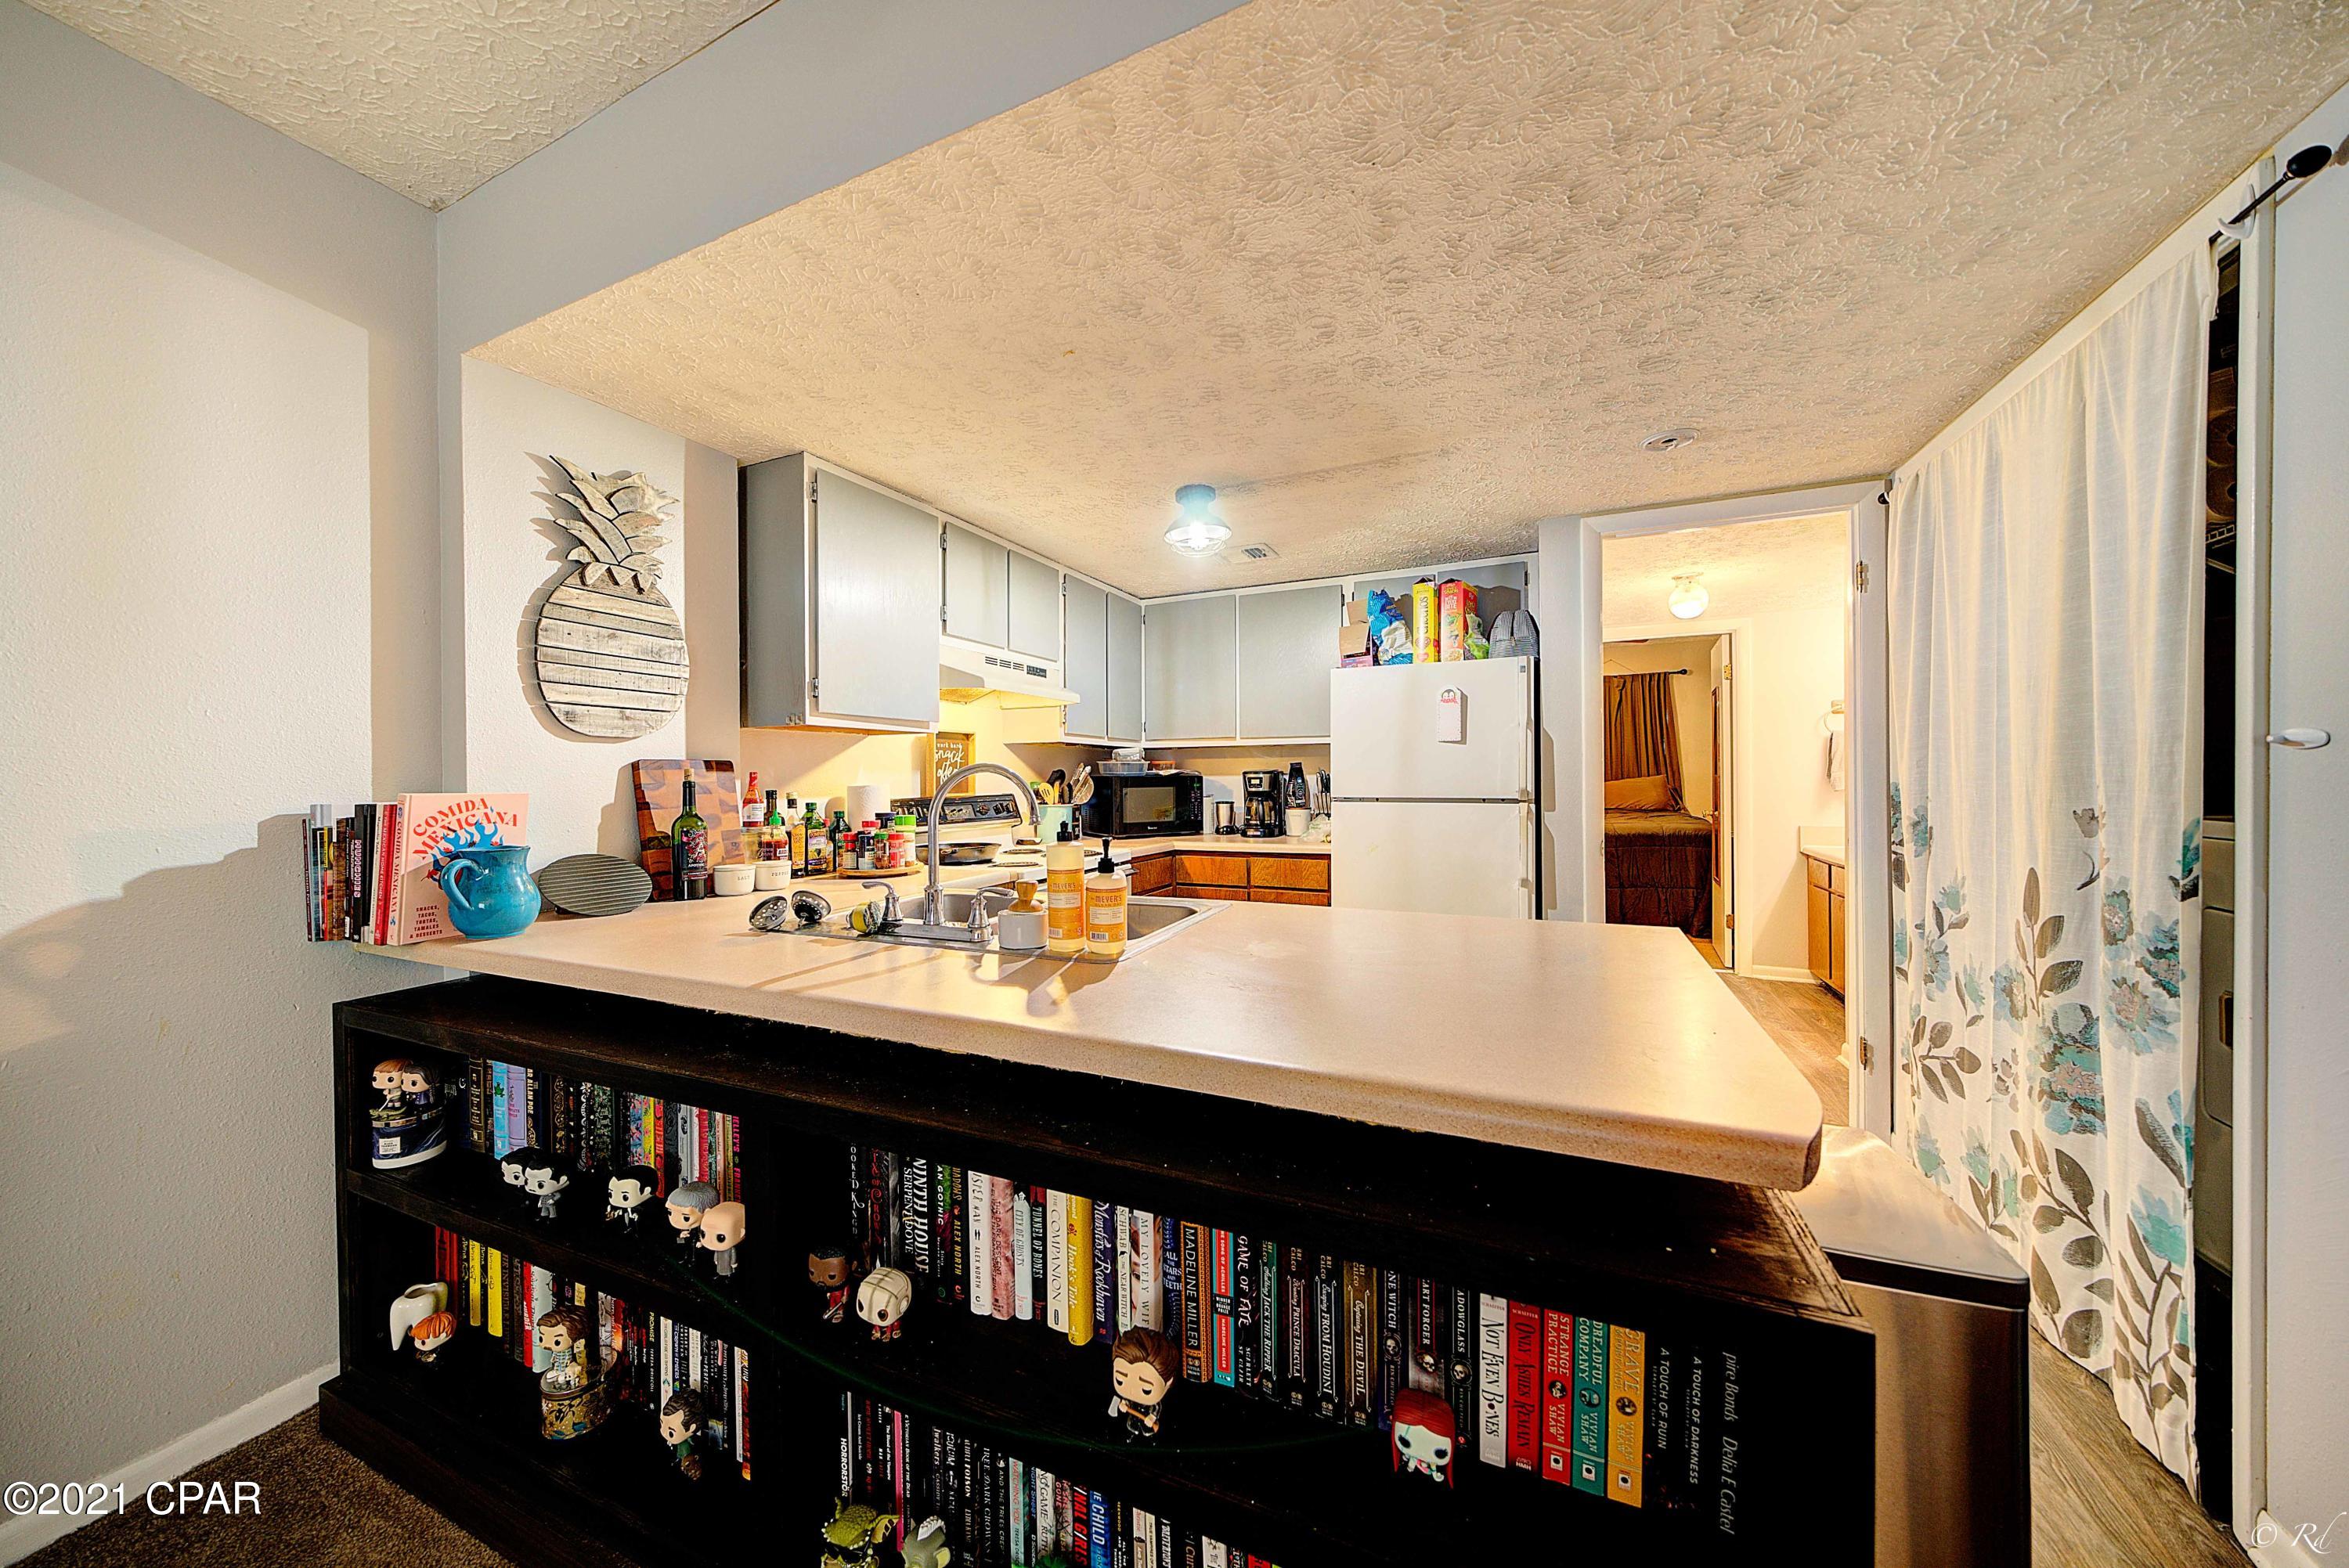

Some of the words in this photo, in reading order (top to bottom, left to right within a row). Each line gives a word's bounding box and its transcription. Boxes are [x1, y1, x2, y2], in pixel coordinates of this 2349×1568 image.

[935, 745, 965, 770] snack
[413, 798, 488, 836] COMIDA
[413, 811, 517, 860] MEXICANA
[391, 863, 399, 913] MEXICANA
[416, 930, 442, 939] DESSERTS
[903, 1167, 913, 1217] SERPENT
[913, 1158, 928, 1213] NINTH
[904, 1220, 913, 1253] DOVE
[1016, 1228, 1023, 1237] OF
[1032, 1207, 1041, 1237] TUNNEL
[1094, 1202, 1110, 1249] Monsters
[1141, 1218, 1148, 1237] MY
[914, 1216, 929, 1272] HOUSE
[1016, 1239, 1024, 1266] GHOSTS
[1033, 1241, 1041, 1250] OF
[1051, 1209, 1062, 1302] COMPANION
[1093, 1249, 1103, 1259] of
[1185, 1228, 1196, 1297] MADELINE
[1238, 1235, 1250, 1271] GAME
[1033, 1253, 1042, 1278] BONES
[1068, 1244, 1077, 1282] Hook's
[1069, 1285, 1077, 1309] Tale
[1095, 1259, 1110, 1321] Rookhaven
[1239, 1276, 1249, 1291] OF
[1187, 1302, 1198, 1346] MILLER
[1239, 1298, 1251, 1328] FATE
[1322, 1312, 1330, 1342] FROM
[1480, 1317, 1504, 1348] NOT
[1515, 1322, 1536, 1354] ONLY
[1547, 1314, 1557, 1374] PRACTICE
[1560, 1316, 1568, 1376] STRANGE
[1579, 1317, 1589, 1381] COMPANY
[1322, 1343, 1332, 1394] HOUDINI
[1482, 1350, 1503, 1387] EVEN
[1592, 1321, 1603, 1385] DREADFUL
[1355, 1360, 1365, 1395] DEVIL
[1514, 1357, 1535, 1397] ASHES
[1659, 1361, 1669, 1398] TOUCH
[1692, 1369, 1701, 1405] TOUCH
[1658, 1403, 1667, 1418] OF
[1691, 1409, 1699, 1424] OF
[1723, 1382, 1738, 1422] Bonds
[1512, 1400, 1535, 1449] REMAIN
[1616, 1424, 1625, 1454] SHAW
[1626, 1422, 1634, 1462] VIVIAN
[1658, 1421, 1667, 1449] RUIN
[840, 1438, 850, 1497] HORRORSTÖR
[1690, 1426, 1699, 1484] DARKNESS
[1722, 1437, 1737, 1473] Delia
[1722, 1476, 1736, 1487] E
[1040, 1487, 1048, 1519] GAME
[1719, 1490, 1735, 1534] Castel
[1092, 1504, 1105, 1545] CHILD
